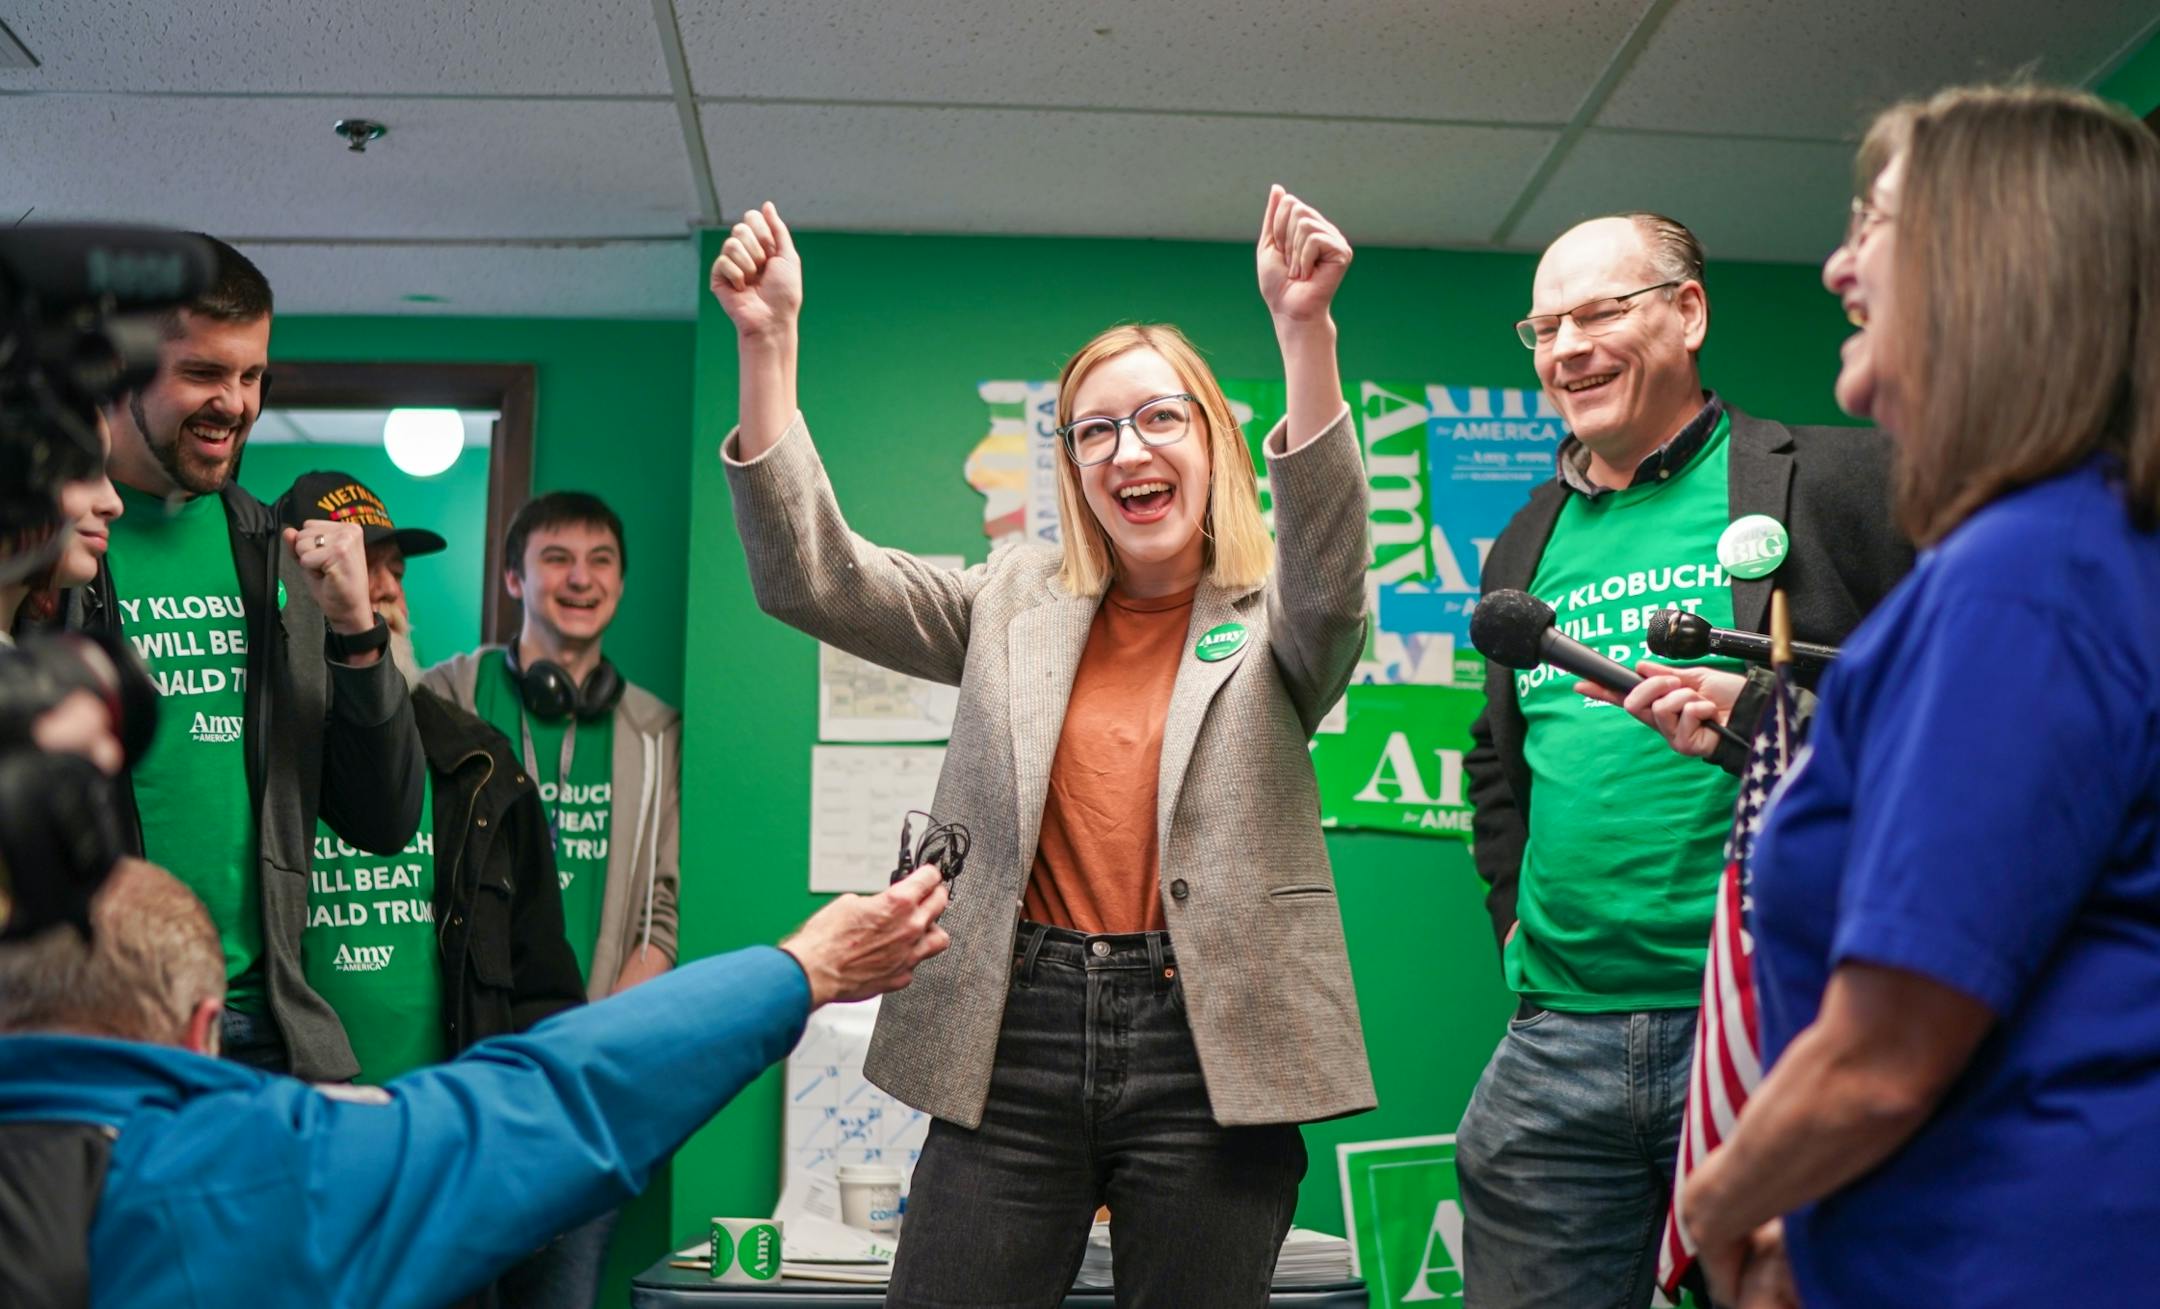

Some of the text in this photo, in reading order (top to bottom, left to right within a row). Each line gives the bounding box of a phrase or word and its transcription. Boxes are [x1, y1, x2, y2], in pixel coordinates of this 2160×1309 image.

[1452, 421, 1556, 441] AMERICA
[1569, 564, 1732, 612] KLOBUCH
[118, 598, 141, 624] Y
[131, 629, 248, 660] WILL BE
[189, 711, 244, 739] Amy
[199, 734, 235, 742] AMERICA
[355, 864, 422, 892] BEAT
[306, 902, 368, 927] ALD
[333, 943, 395, 968] Amy
[754, 1227, 771, 1276] Amy
